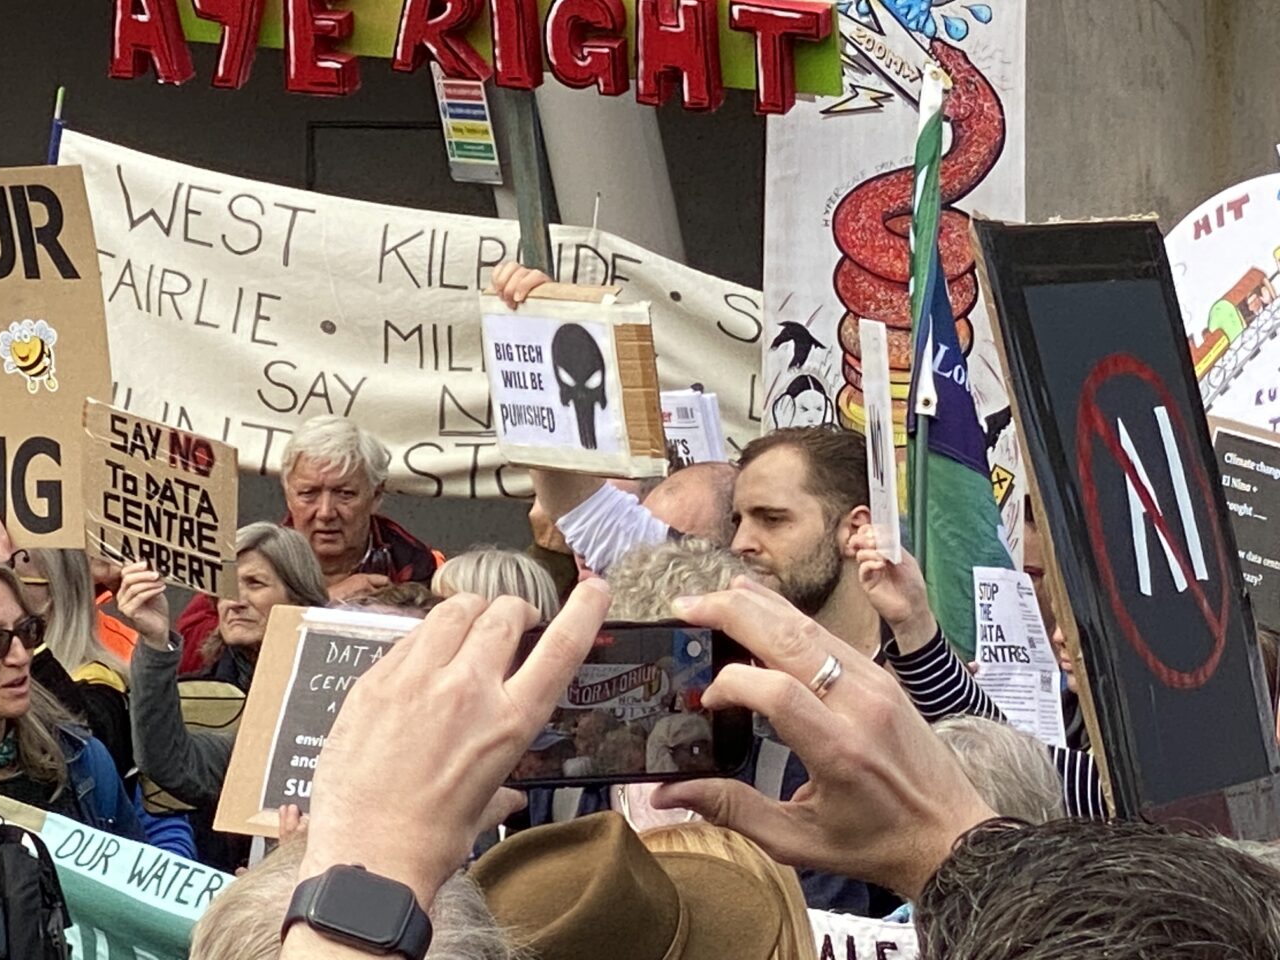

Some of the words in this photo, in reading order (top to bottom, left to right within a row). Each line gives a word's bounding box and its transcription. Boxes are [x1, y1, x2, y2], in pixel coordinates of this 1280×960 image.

[116, 163, 317, 268] WEST
[1193, 192, 1251, 241] HIT
[98, 248, 282, 347] AIRLIE
[494, 342, 514, 362] BIG
[517, 344, 544, 365] TECH
[257, 360, 369, 418] SAY
[501, 370, 529, 390] WILL
[530, 372, 544, 391] BE
[500, 403, 555, 434] PUNISHED
[110, 414, 162, 461] SAY
[169, 428, 216, 478] NO
[145, 472, 219, 523] DATA
[103, 492, 221, 558] CENTRE
[100, 527, 223, 593] LARBERT
[979, 581, 999, 601] STOP
[326, 642, 386, 667] DATA
[980, 624, 1006, 642] ATA
[981, 644, 1031, 664] ENTRES
[290, 754, 320, 769] and
[55, 828, 120, 876] OUR
[126, 847, 224, 908] WATER
